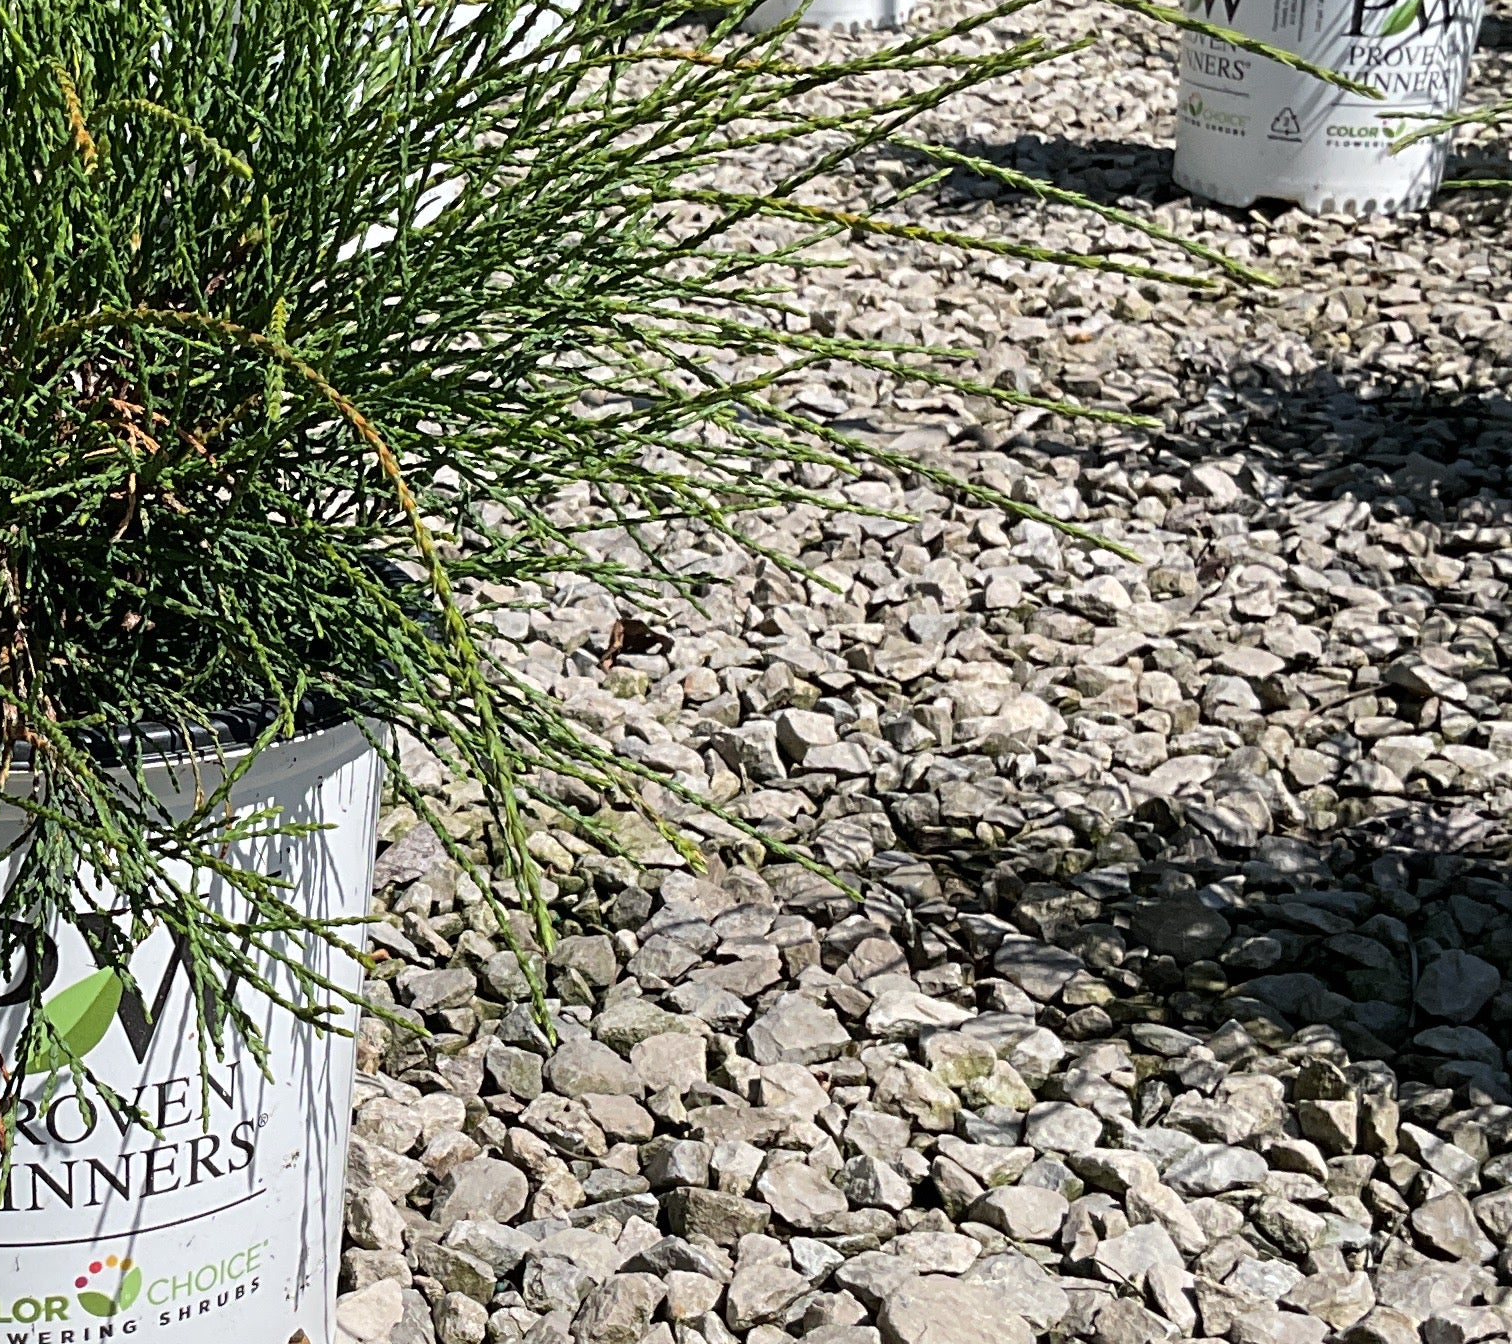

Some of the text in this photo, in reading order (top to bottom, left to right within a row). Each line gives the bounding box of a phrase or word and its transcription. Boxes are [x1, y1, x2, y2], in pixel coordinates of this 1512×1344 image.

[1349, 44, 1449, 67] PROVEN
[1326, 125, 1379, 139] COLOR
[146, 1241, 262, 1306] CHOICE
[159, 1276, 261, 1327] SHRUBS
